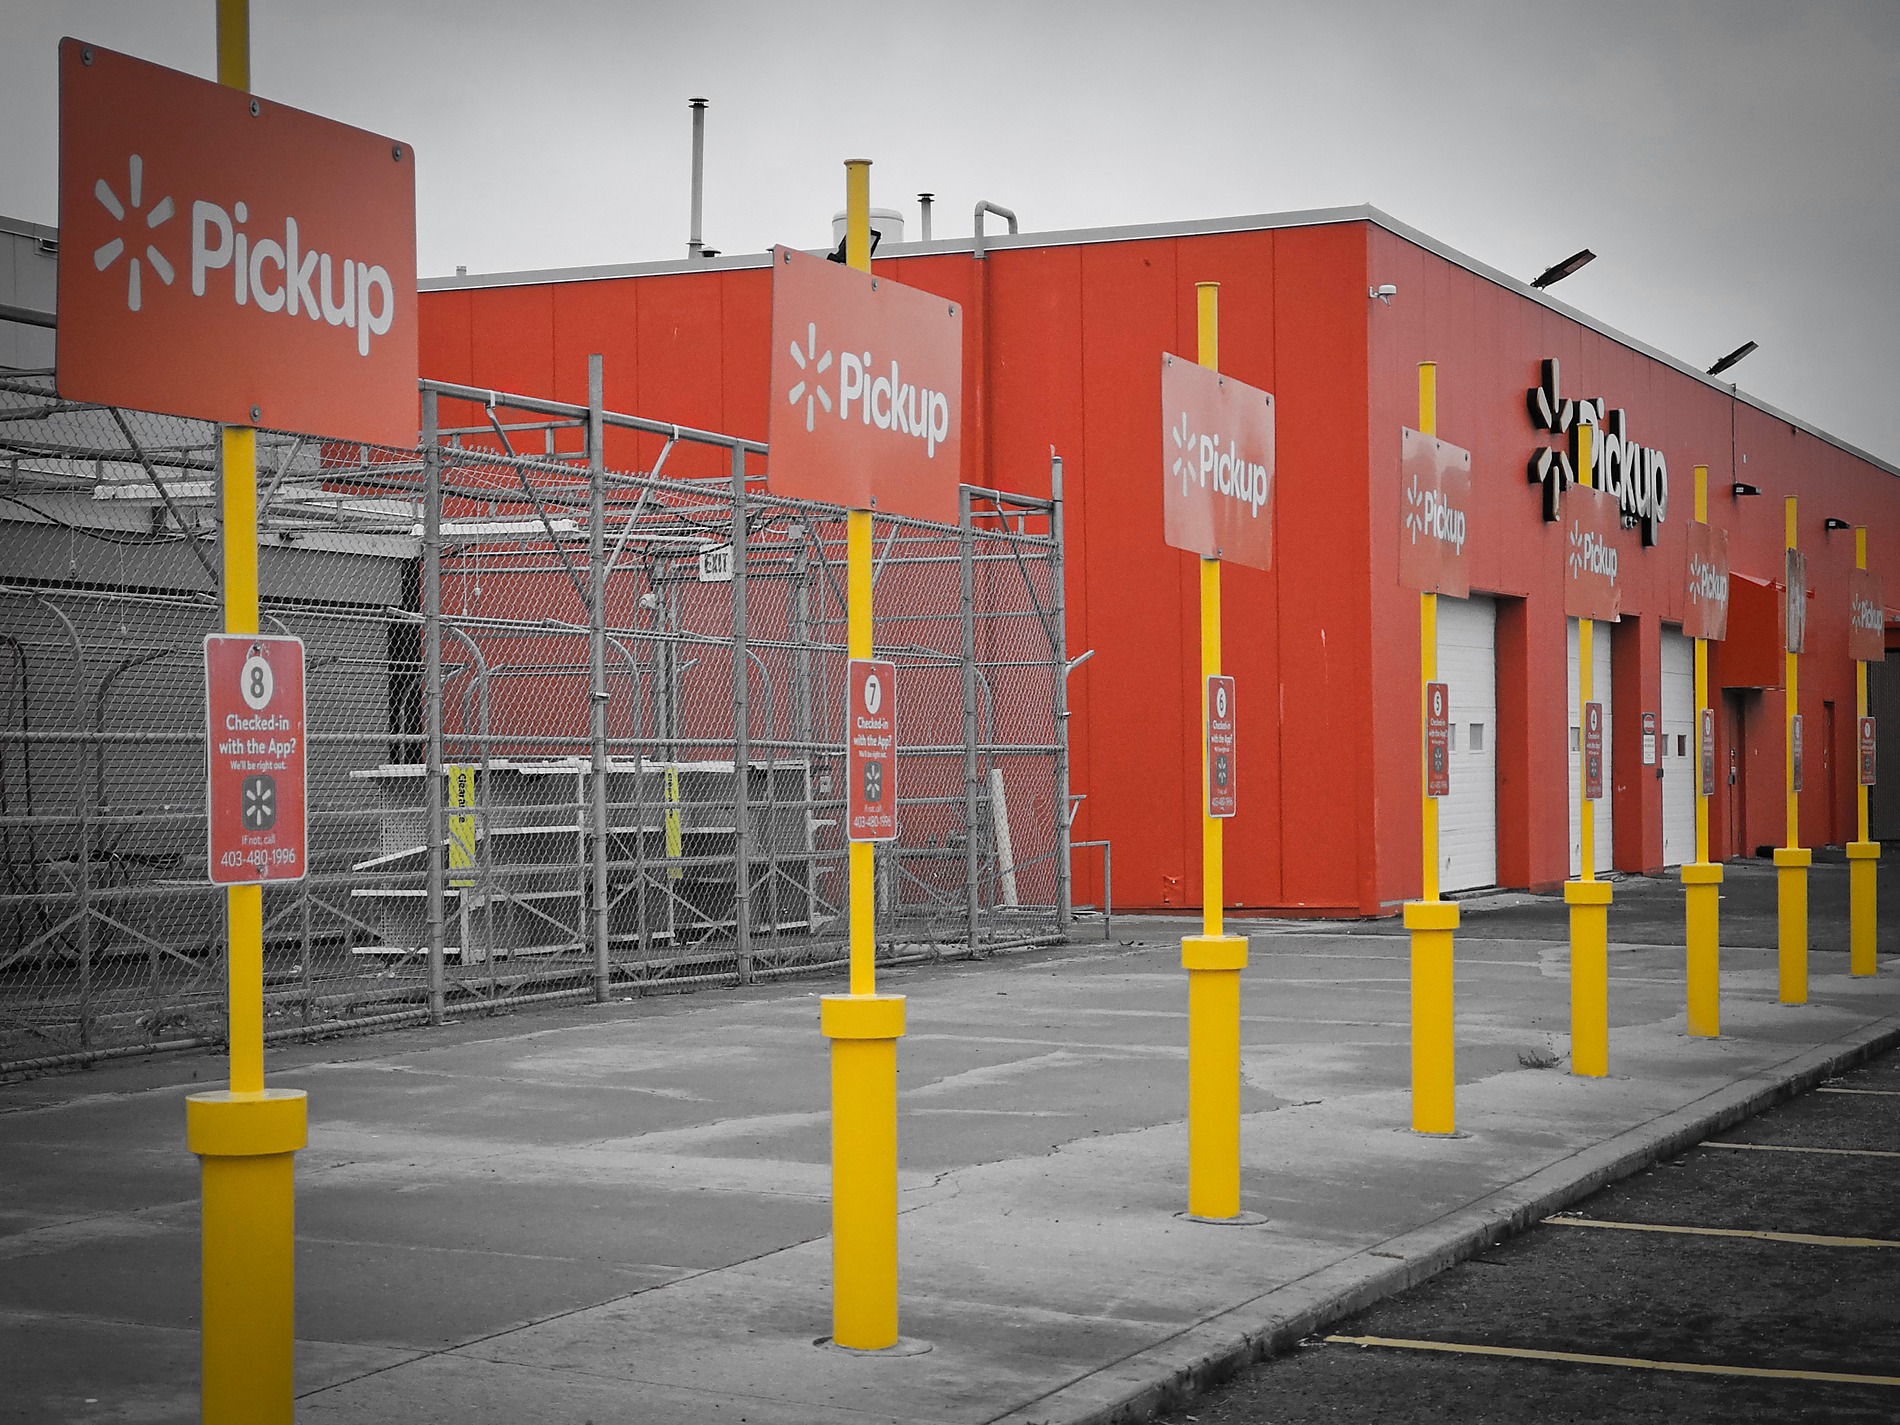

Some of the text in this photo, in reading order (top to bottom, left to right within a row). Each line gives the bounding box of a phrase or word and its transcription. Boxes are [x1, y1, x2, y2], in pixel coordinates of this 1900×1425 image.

[192, 200, 394, 357] Pickup
[840, 350, 949, 459] Pickup
[1200, 433, 1268, 519] Pickup
[1576, 396, 1669, 547] Pickup
[1424, 488, 1466, 556] Pickup
[704, 552, 729, 574] EXIT
[1583, 531, 1618, 588] Pickup
[250, 666, 265, 699] 8
[869, 682, 877, 706] 7
[225, 713, 290, 731] Checked-in
[219, 737, 297, 759] with the App?
[246, 760, 256, 770] be
[256, 760, 273, 773] right
[458, 773, 467, 823] Clearane
[263, 834, 276, 845] call
[220, 848, 296, 867] 403-480-1996
